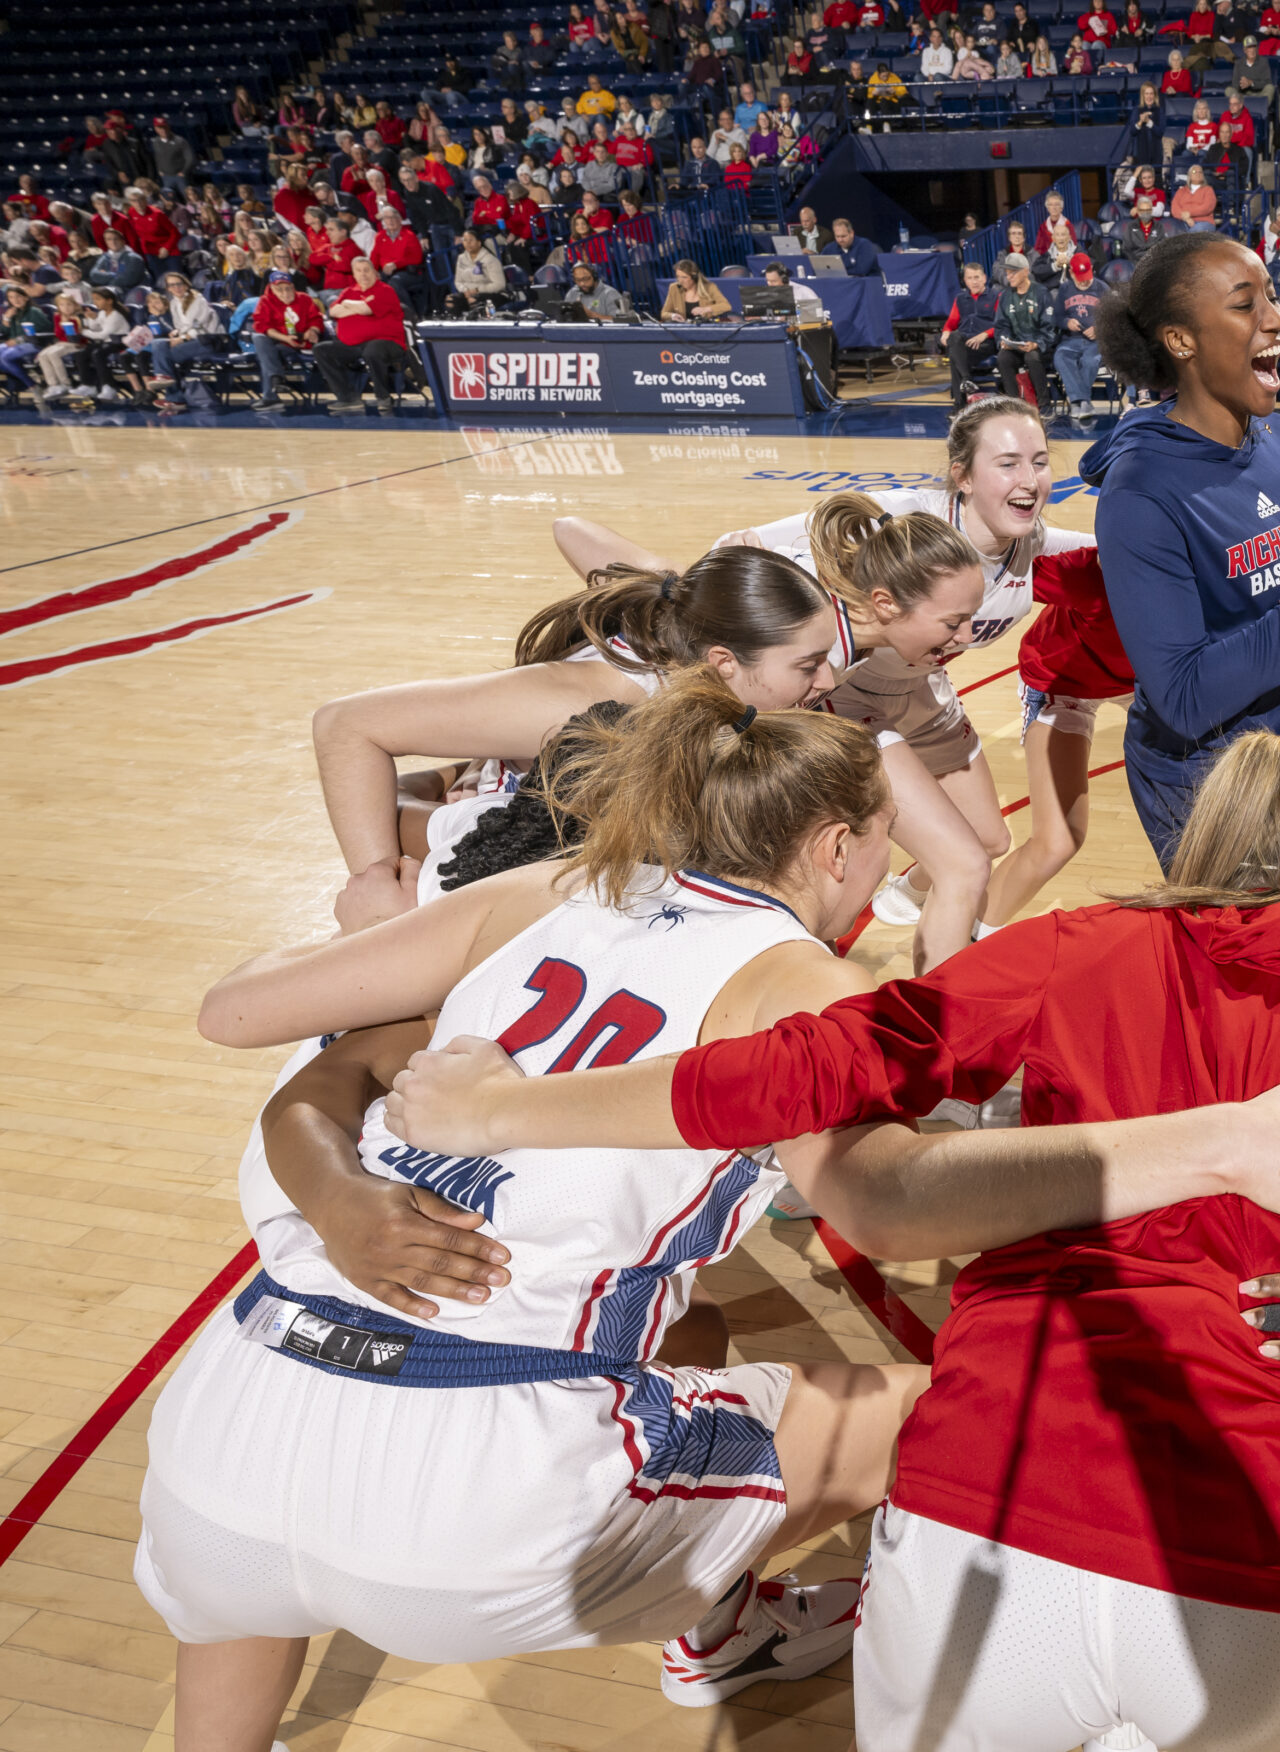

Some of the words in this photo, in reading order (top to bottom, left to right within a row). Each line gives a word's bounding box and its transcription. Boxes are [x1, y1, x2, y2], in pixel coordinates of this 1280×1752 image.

[674, 352, 731, 366] CapCenter
[488, 352, 601, 387] SPIDER
[633, 370, 668, 386] Zero
[671, 370, 728, 389] Closing
[730, 371, 767, 387] Cost
[489, 387, 536, 401] SPORTS
[540, 387, 602, 402] NETWORK
[661, 390, 745, 407] mortgages.
[743, 470, 943, 483] cours
[1258, 504, 1280, 519] adidas
[370, 1340, 405, 1352] adidas
